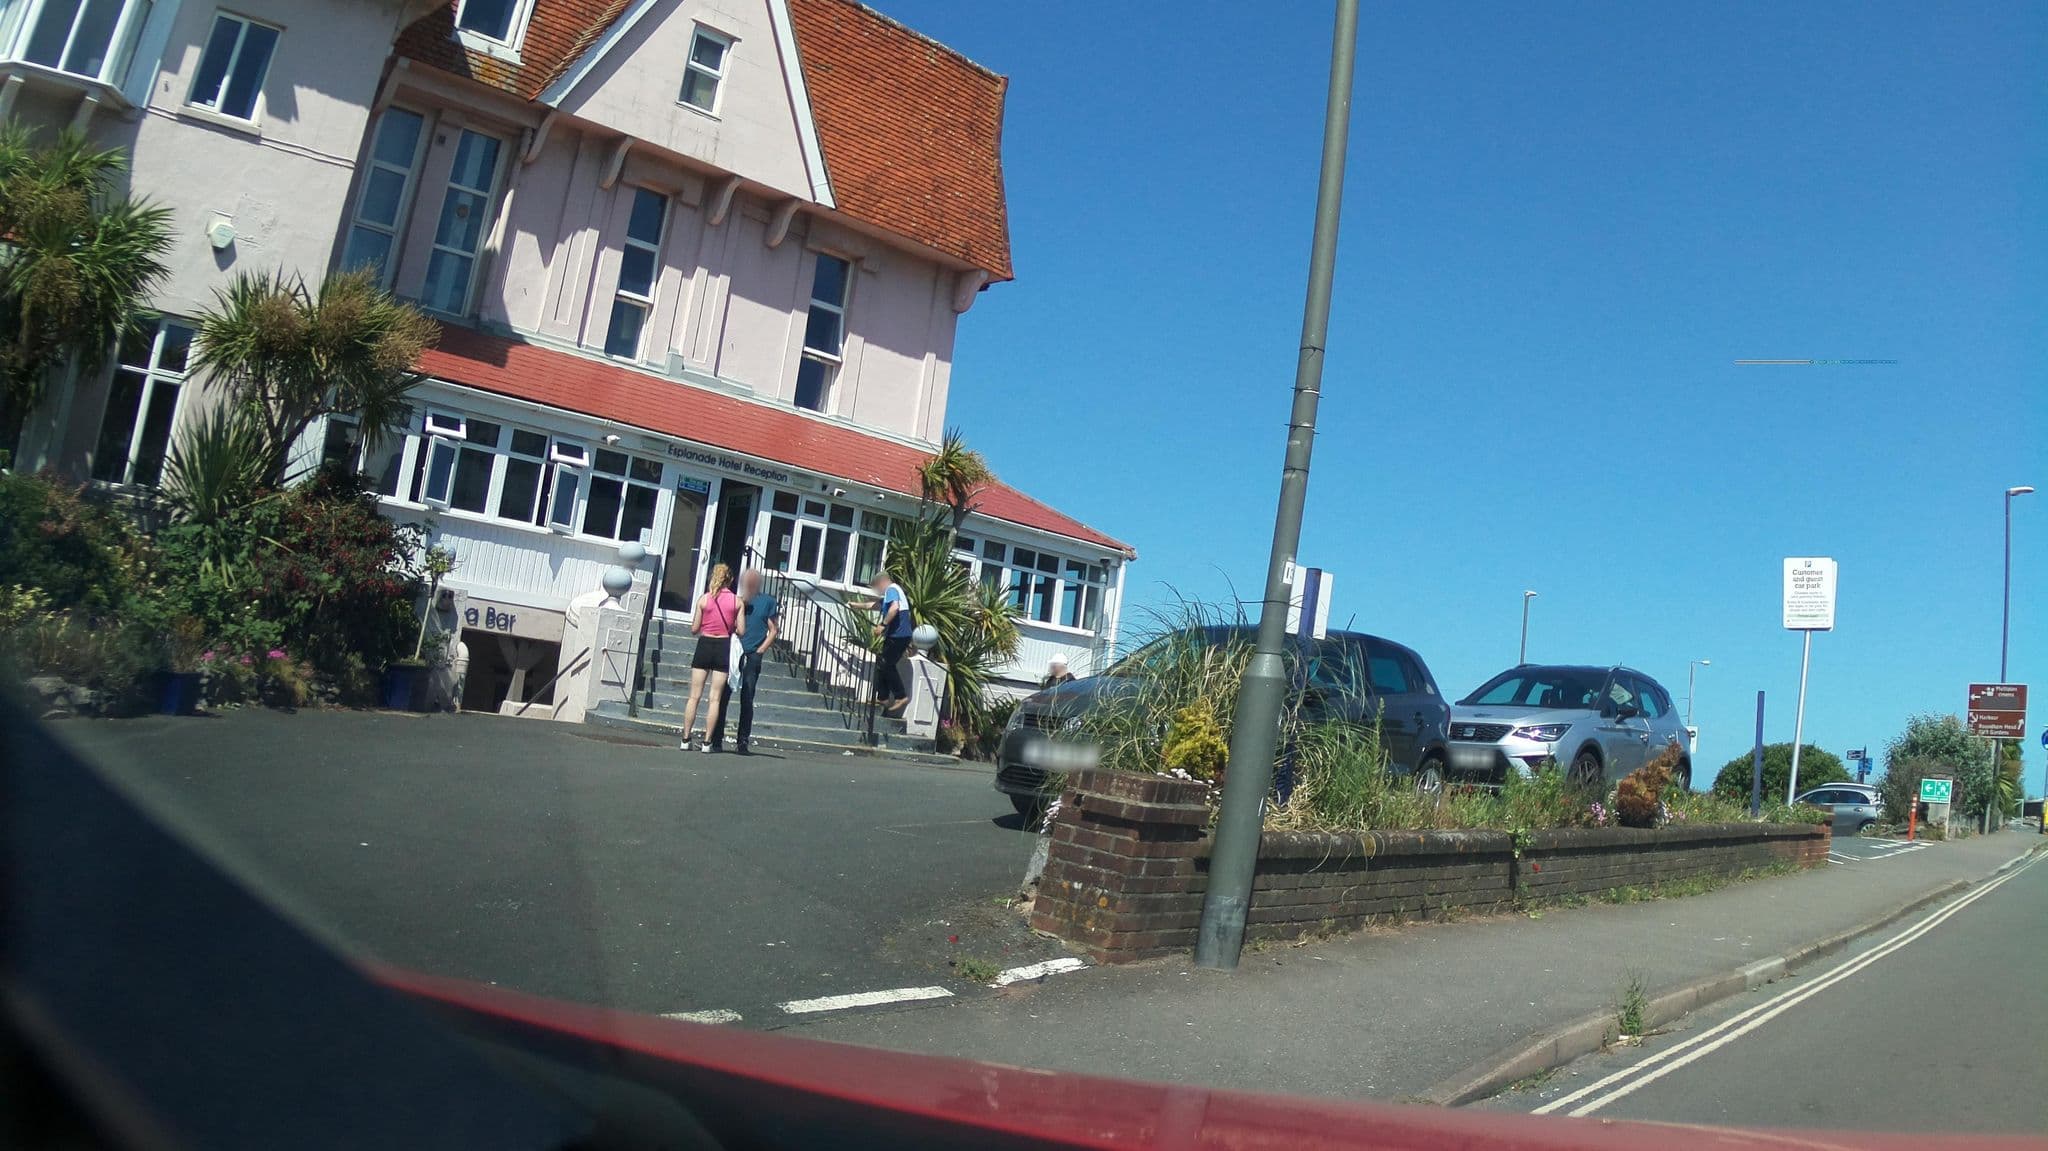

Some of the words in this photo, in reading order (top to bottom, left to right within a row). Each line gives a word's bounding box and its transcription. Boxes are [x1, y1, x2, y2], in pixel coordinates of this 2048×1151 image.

[667, 444, 717, 465] Esplanade
[718, 457, 743, 471] Hotel
[744, 463, 788, 483] Reception
[1806, 582, 1821, 590] park
[486, 606, 517, 633] Bar
